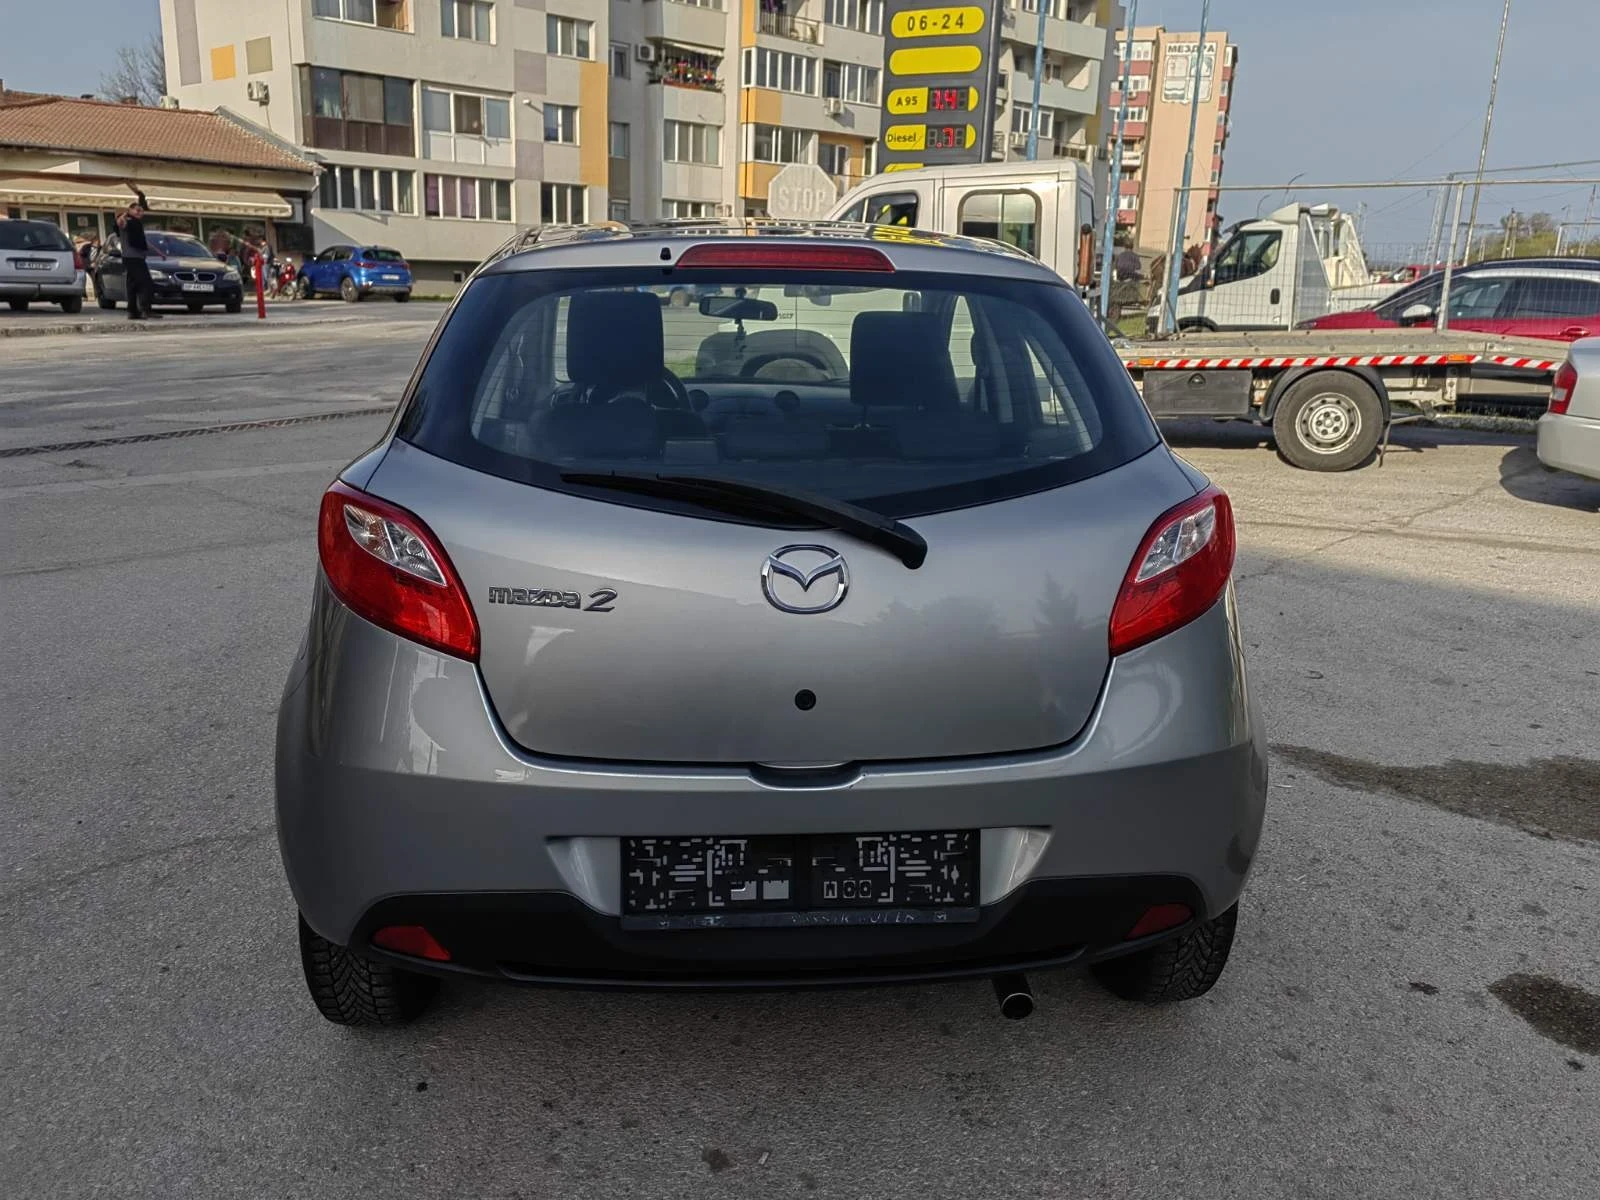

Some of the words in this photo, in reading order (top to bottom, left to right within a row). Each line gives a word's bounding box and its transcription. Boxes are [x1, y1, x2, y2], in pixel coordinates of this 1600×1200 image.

[907, 13, 964, 31] 06-24
[887, 133, 917, 143] Diesel
[779, 187, 826, 212] STOP
[584, 587, 618, 613] 2
